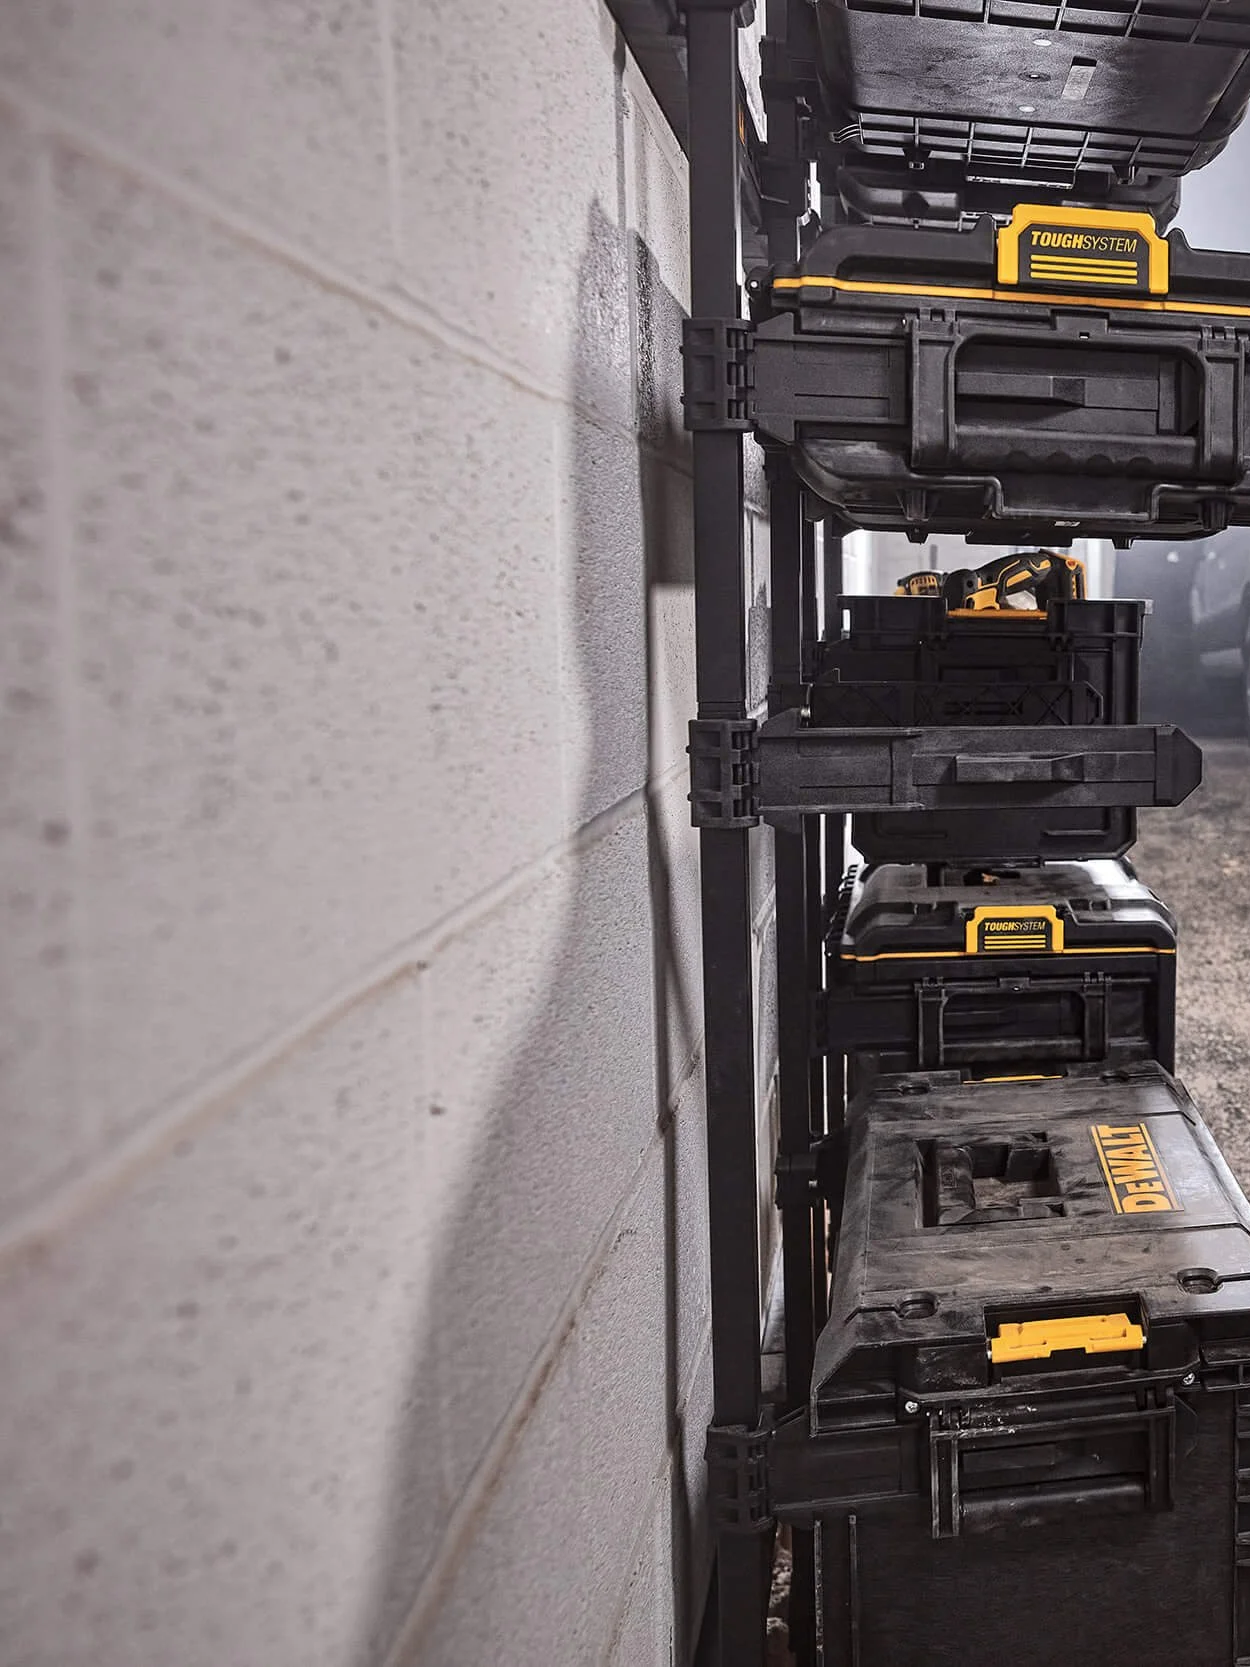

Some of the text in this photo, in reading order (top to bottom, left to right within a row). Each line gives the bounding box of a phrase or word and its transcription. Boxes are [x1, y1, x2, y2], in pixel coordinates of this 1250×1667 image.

[1031, 230, 1137, 253] TOUGHSYSTEM
[984, 921, 1046, 932] TOUGHSYSTEM
[1097, 1124, 1174, 1214] DEWALT
